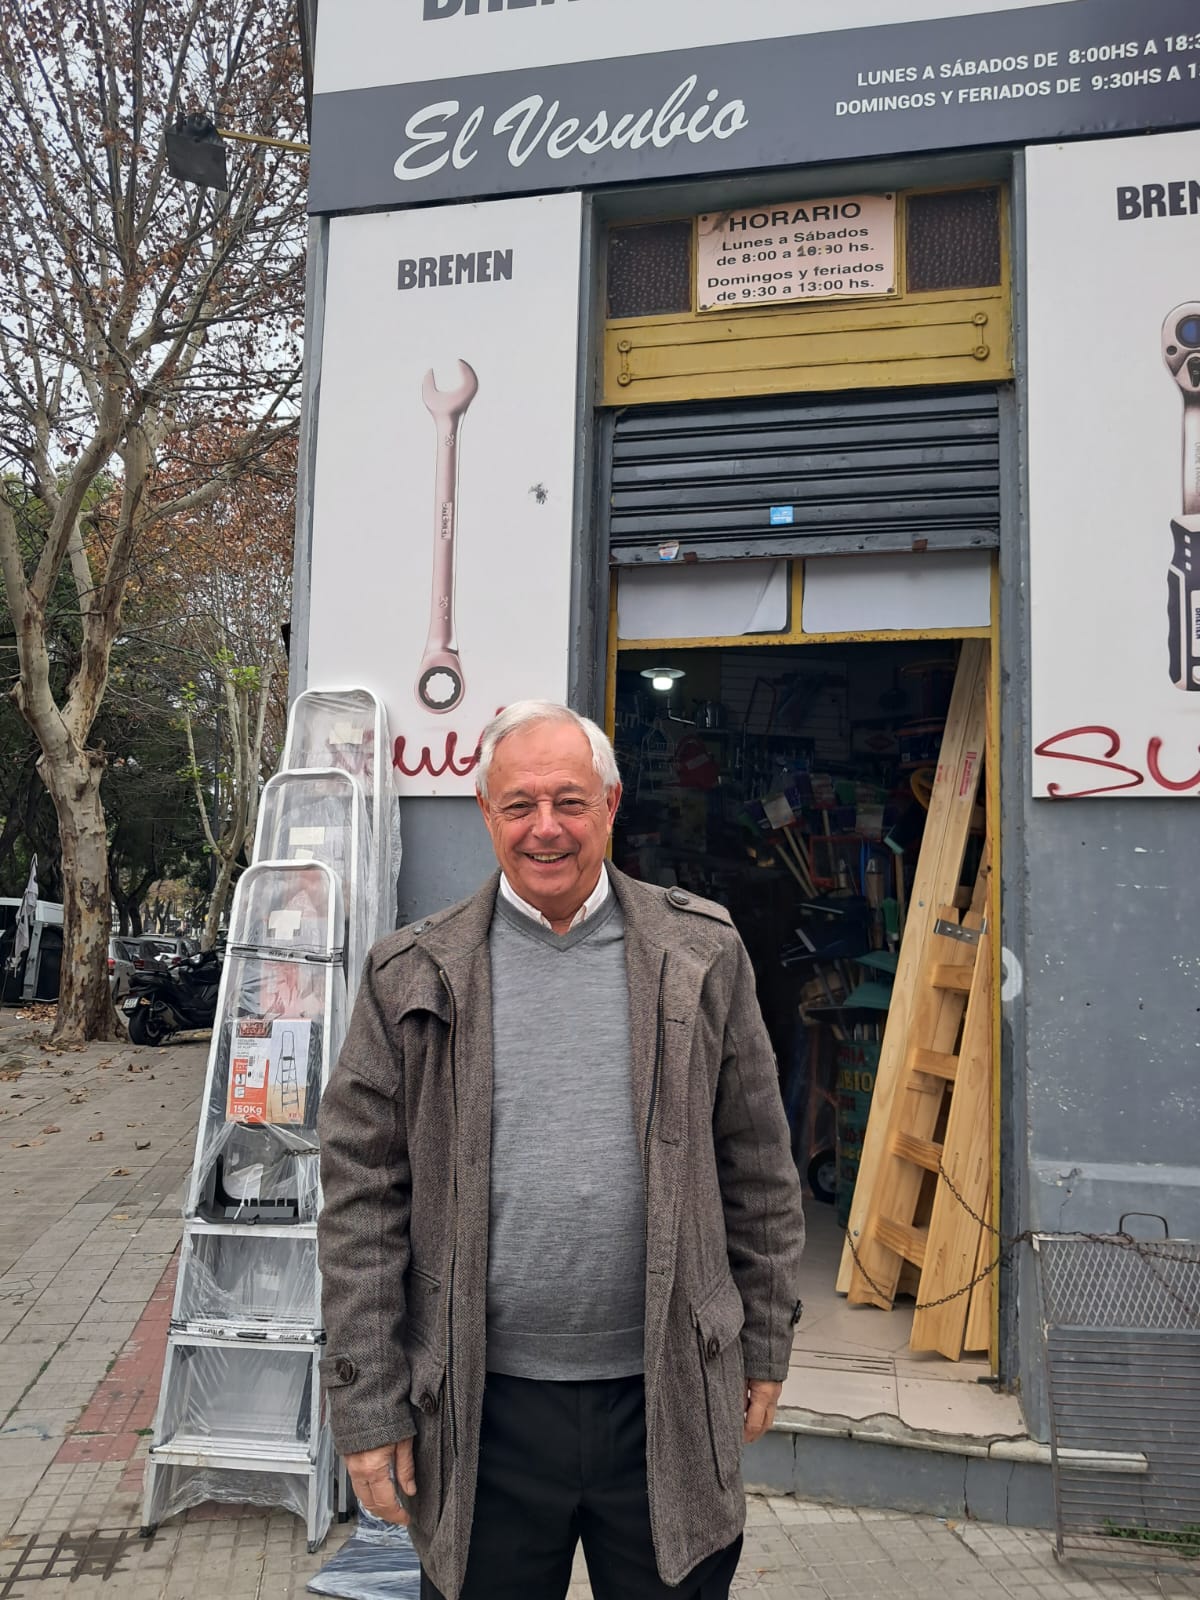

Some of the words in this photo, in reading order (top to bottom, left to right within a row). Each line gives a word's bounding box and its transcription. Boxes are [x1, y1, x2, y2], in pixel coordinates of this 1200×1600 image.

[857, 67, 917, 87] LUNES
[922, 63, 935, 79] A
[940, 55, 1028, 78] SÁBADOS
[1034, 52, 1058, 68] DE
[1069, 42, 1138, 64] 8:00HS
[1144, 39, 1158, 55] A
[835, 92, 936, 116] DOMINGOS
[941, 91, 953, 105] Y
[958, 80, 1051, 104] FERIADOS
[1056, 77, 1081, 94] DE
[1091, 68, 1162, 91] 9:30HS
[1167, 66, 1181, 82] A
[393, 100, 484, 181] El
[493, 74, 748, 167] Vesubio
[729, 202, 861, 232] HORARIO
[722, 237, 773, 251] Lunes
[778, 236, 788, 245] a
[794, 227, 869, 244] Sábados
[397, 248, 513, 290] BREMEN
[716, 254, 737, 267] de
[742, 250, 777, 264] 8:00
[782, 250, 792, 259] a
[848, 242, 875, 253] hs.
[707, 270, 793, 288] Domingos
[799, 269, 808, 281] y
[813, 261, 885, 276] feriados
[716, 290, 737, 303] de
[742, 285, 777, 299] 9:30
[782, 285, 792, 294] a
[798, 279, 843, 293] 13:00
[848, 278, 875, 290] hs.
